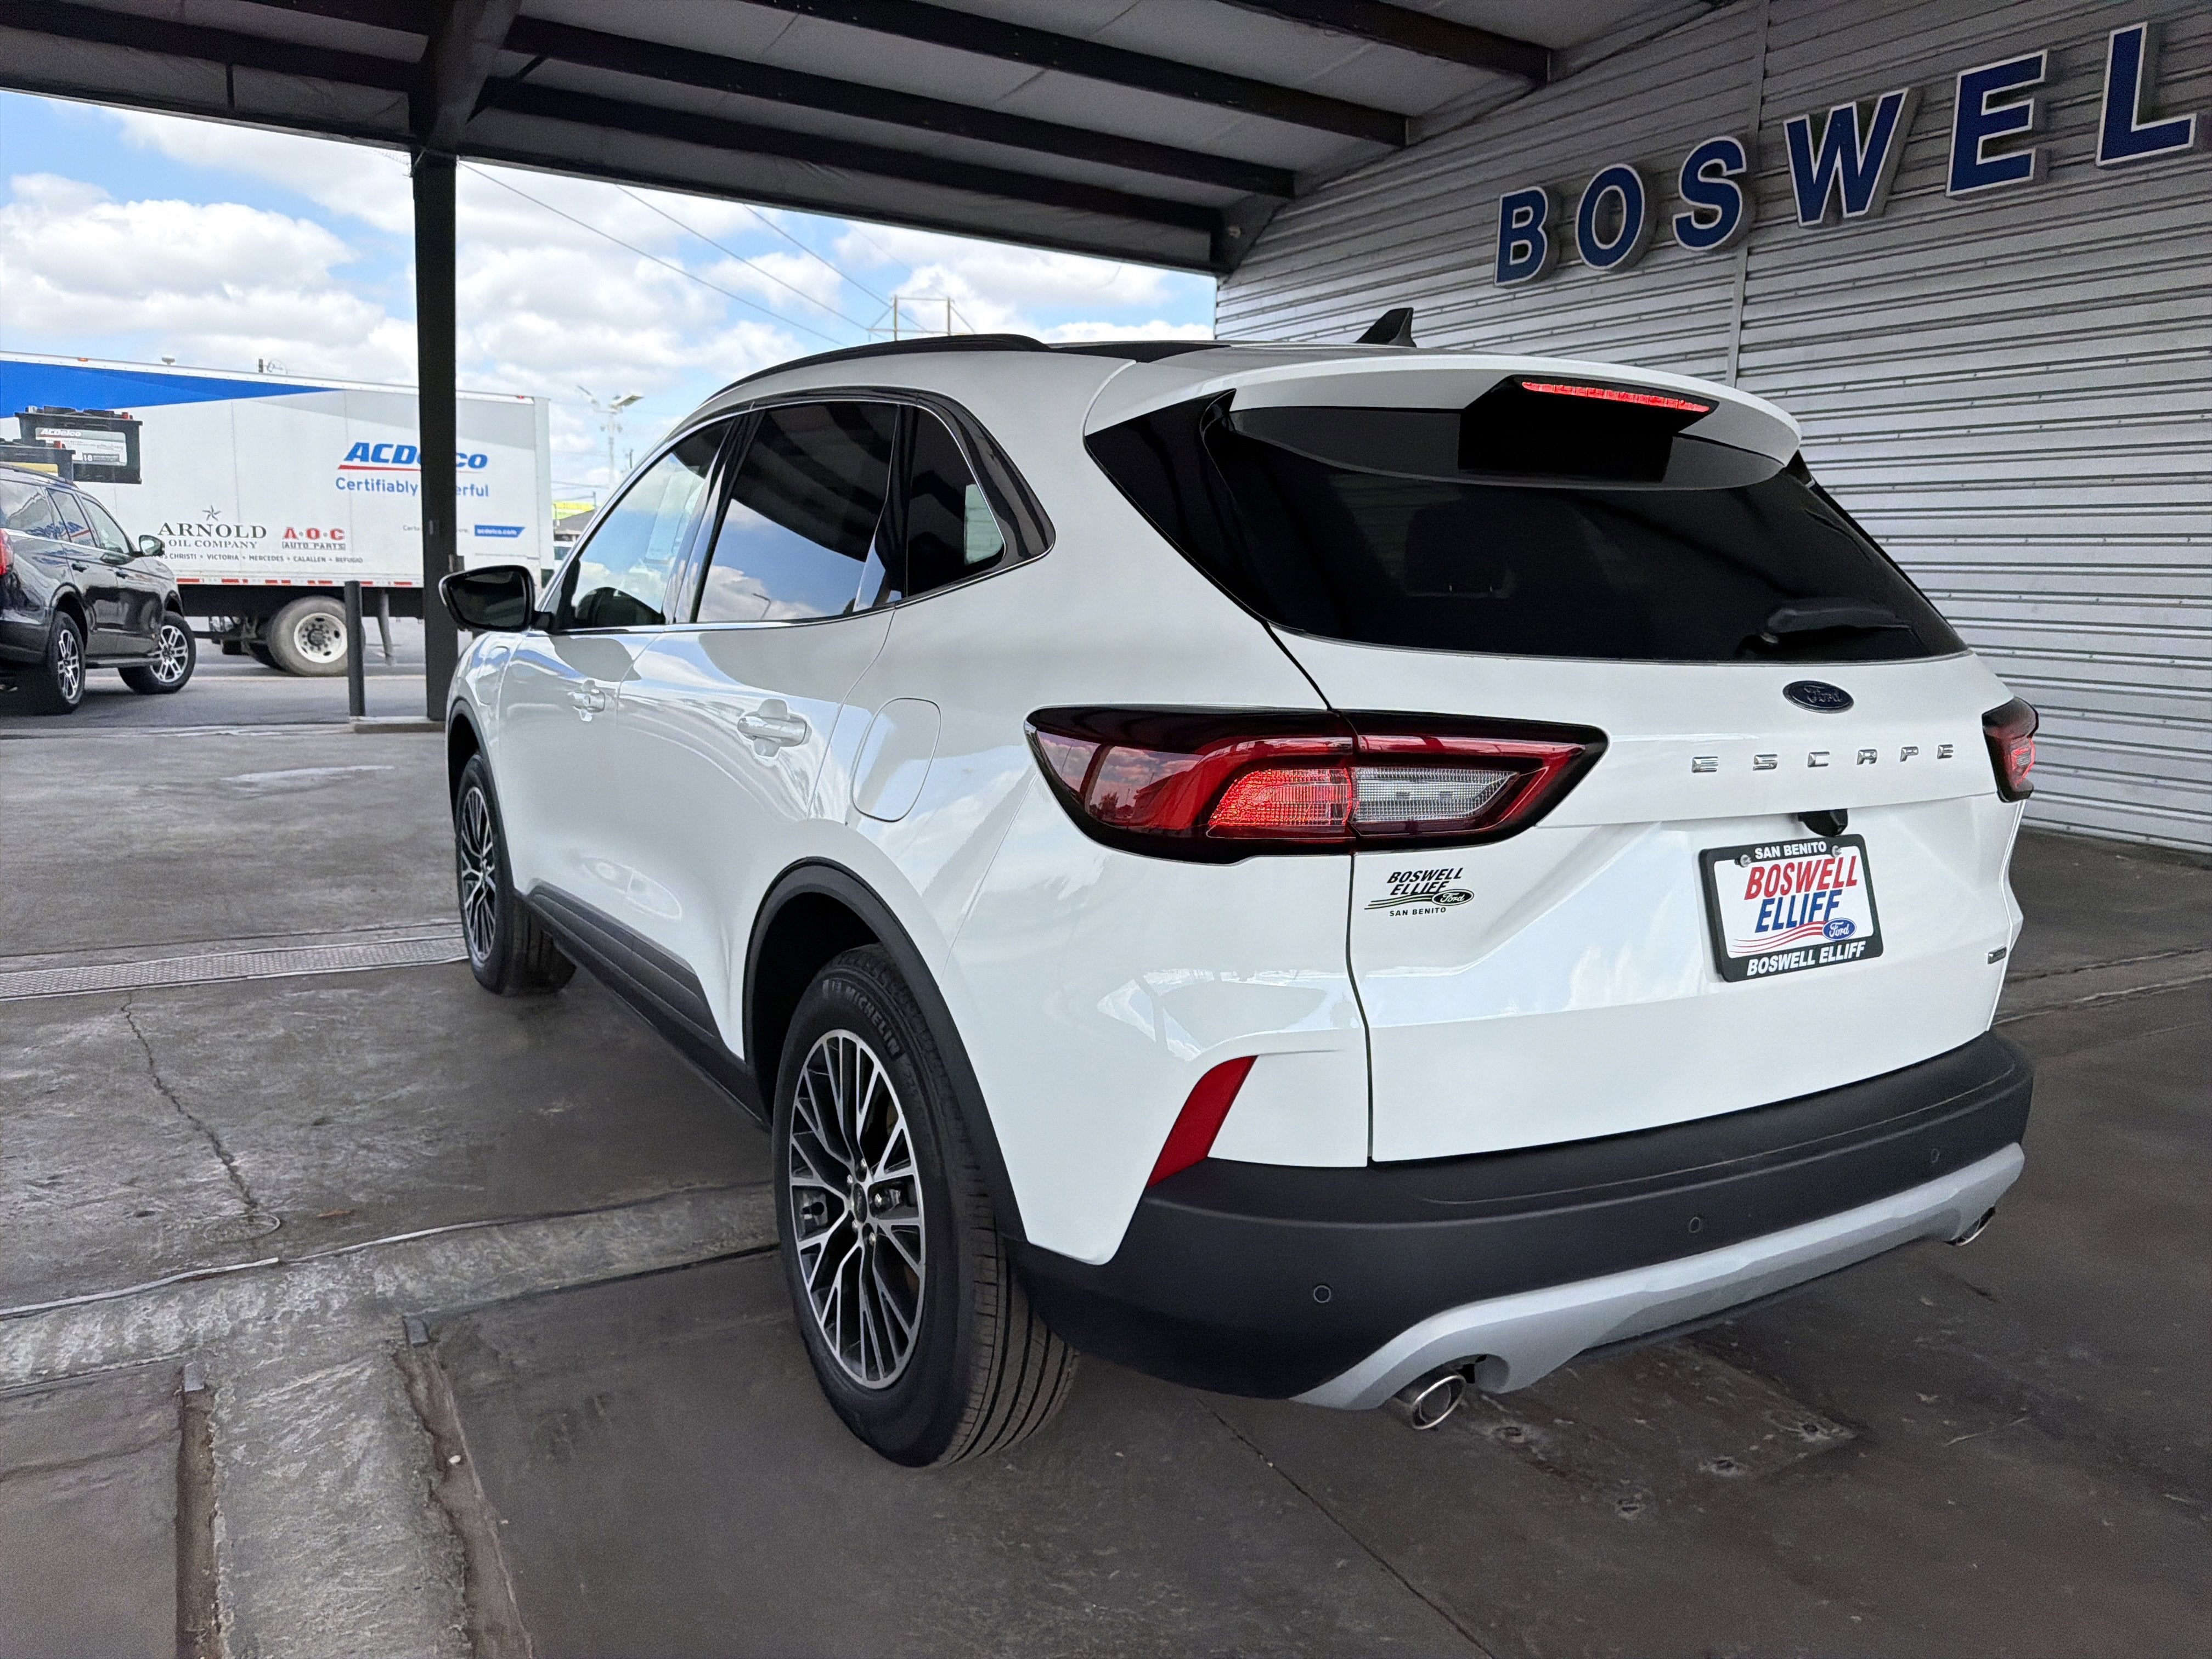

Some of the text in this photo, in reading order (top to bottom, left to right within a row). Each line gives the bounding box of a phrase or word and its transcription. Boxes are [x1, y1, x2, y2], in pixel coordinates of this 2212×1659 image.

[343, 442, 488, 469] ACDco
[336, 477, 418, 496] Certifiably
[157, 522, 267, 539] ARNOLD
[194, 540, 257, 549] COMPANY
[1691, 744, 1954, 773] ESCAPE
[1755, 841, 1827, 860] SAN BENITO
[1386, 867, 1464, 884] BOSWELL
[1743, 855, 1858, 900] BOSWELL
[1389, 881, 1450, 896] ELLIFF
[1440, 892, 1465, 902] Ford
[1412, 907, 1447, 915] BENITO
[1754, 889, 1843, 934] ELLIFF
[1746, 941, 1866, 977] BOSWELL ELLIFF
[845, 986, 900, 1056] MICHELIN
